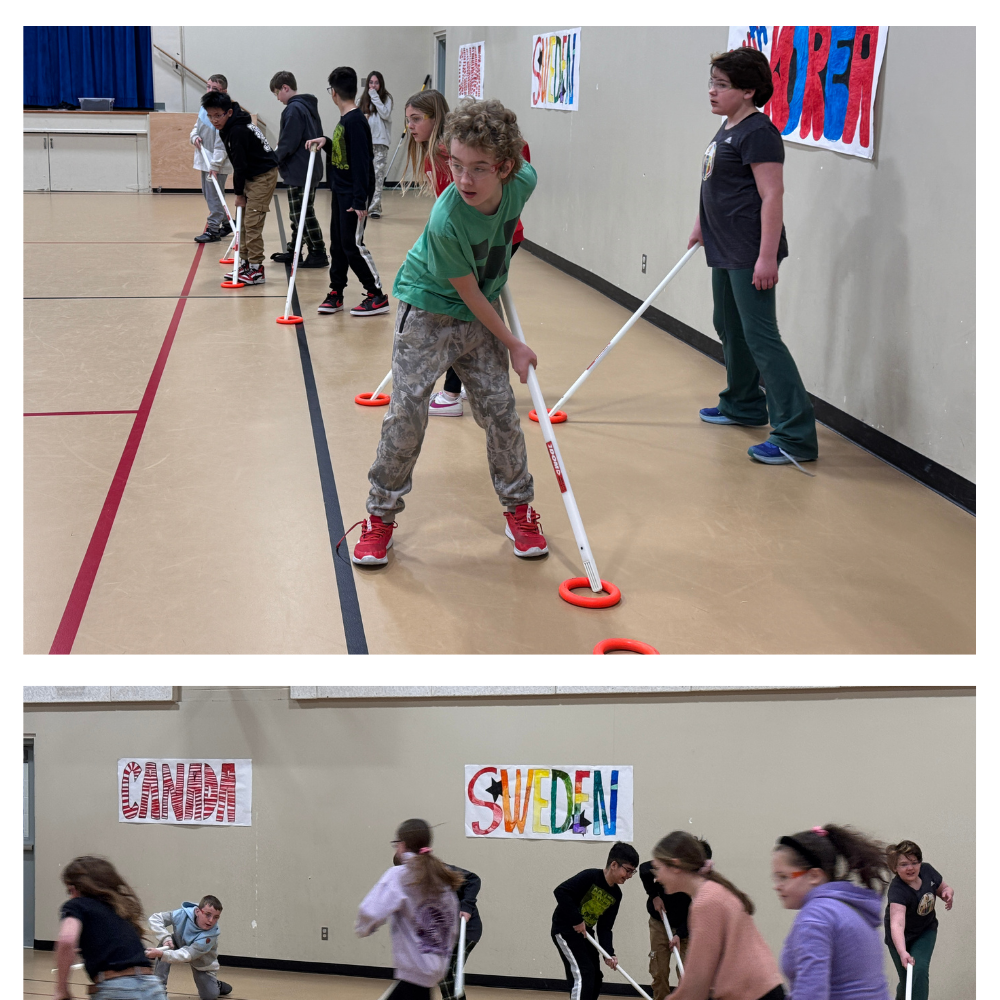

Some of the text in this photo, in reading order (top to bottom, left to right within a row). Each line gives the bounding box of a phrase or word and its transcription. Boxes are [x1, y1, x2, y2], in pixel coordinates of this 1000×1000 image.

[532, 33, 577, 105] SWEDEN
[121, 761, 236, 823] CANADA
[467, 766, 619, 836] SWEDEN
